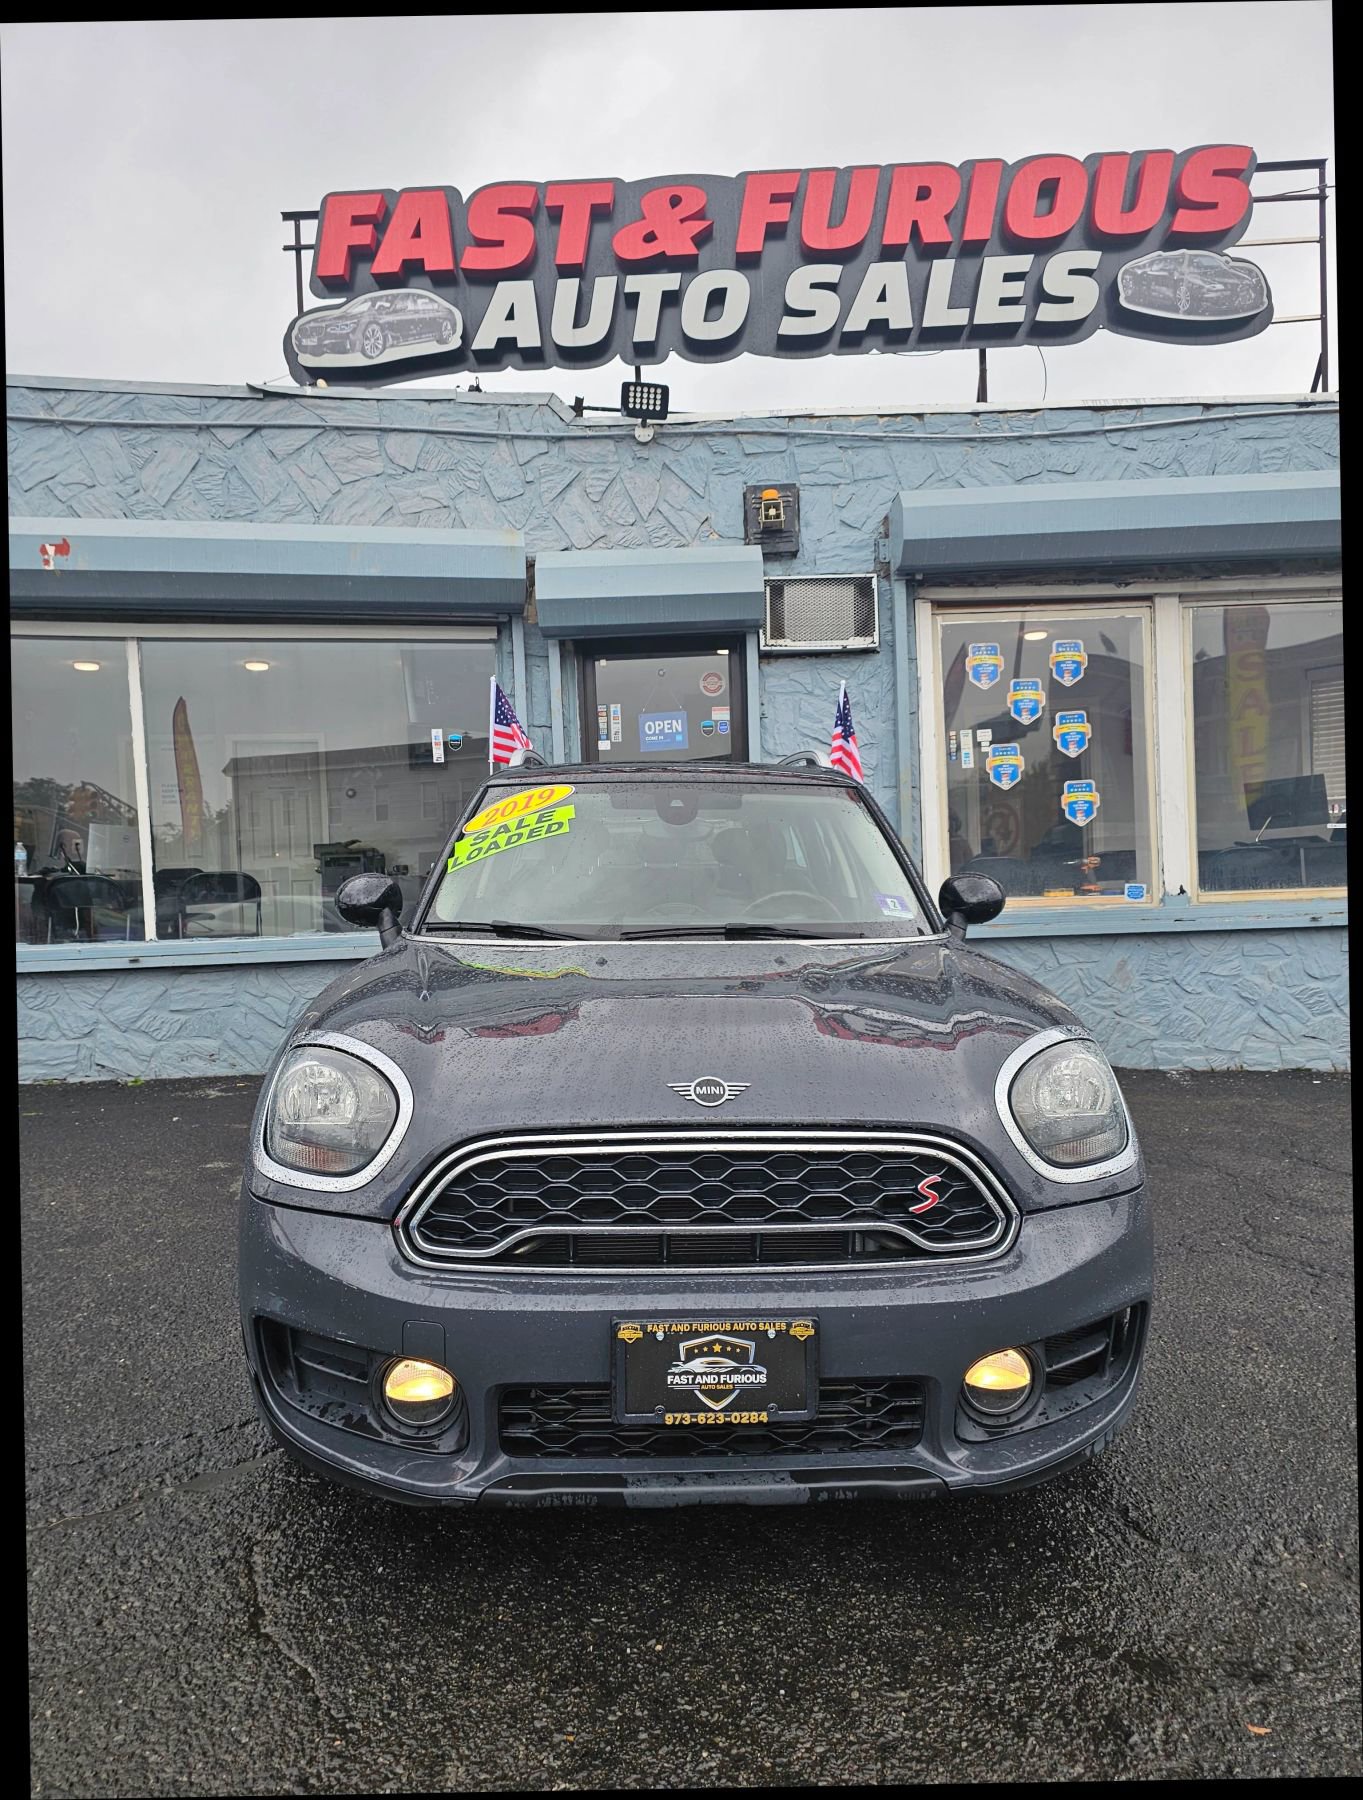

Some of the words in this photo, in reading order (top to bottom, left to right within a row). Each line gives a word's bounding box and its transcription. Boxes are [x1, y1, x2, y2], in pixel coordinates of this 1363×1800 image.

[316, 182, 615, 281] FAST
[611, 184, 714, 263] &
[735, 146, 1254, 257] FURIOUS
[471, 269, 751, 352] AUTO
[777, 250, 1102, 337] SALES
[645, 719, 682, 735] OPEN
[481, 788, 555, 828] 2019
[450, 821, 564, 870] LOADED
[469, 809, 556, 847] SALE
[695, 1086, 724, 1095] MINI
[908, 1175, 942, 1214] S
[647, 1324, 669, 1333] FAST
[671, 1324, 690, 1332] AND
[692, 1323, 731, 1332] FURIOUS
[733, 1322, 757, 1331] AUTO
[758, 1322, 787, 1331] SALES
[667, 1375, 694, 1385] FAST
[695, 1375, 718, 1384] AND
[720, 1374, 767, 1383] FURIOUS
[664, 1411, 768, 1425] 973-623-0284
